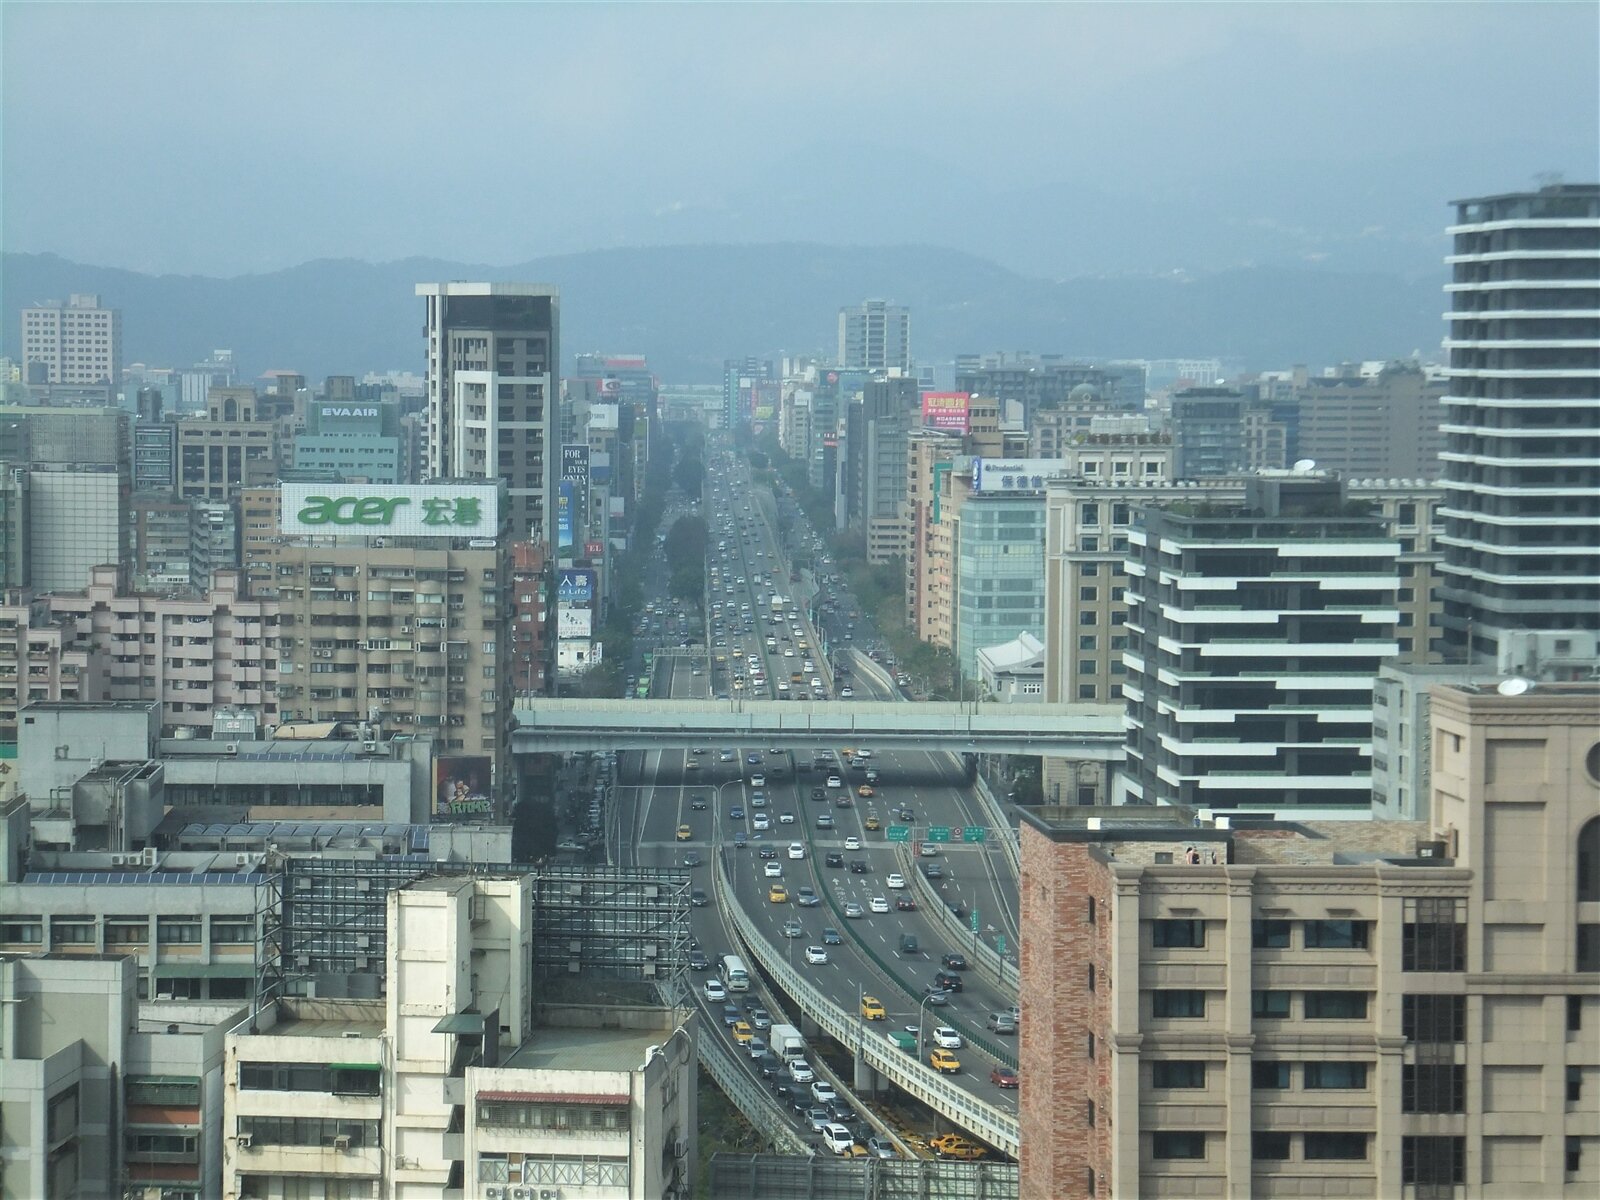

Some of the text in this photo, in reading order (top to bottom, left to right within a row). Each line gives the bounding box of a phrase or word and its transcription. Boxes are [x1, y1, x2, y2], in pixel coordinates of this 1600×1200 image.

[322, 408, 378, 417] EVA AIR
[564, 449, 581, 458] FOR
[298, 496, 482, 526] acer 宏碁
[560, 574, 588, 587] 人壽
